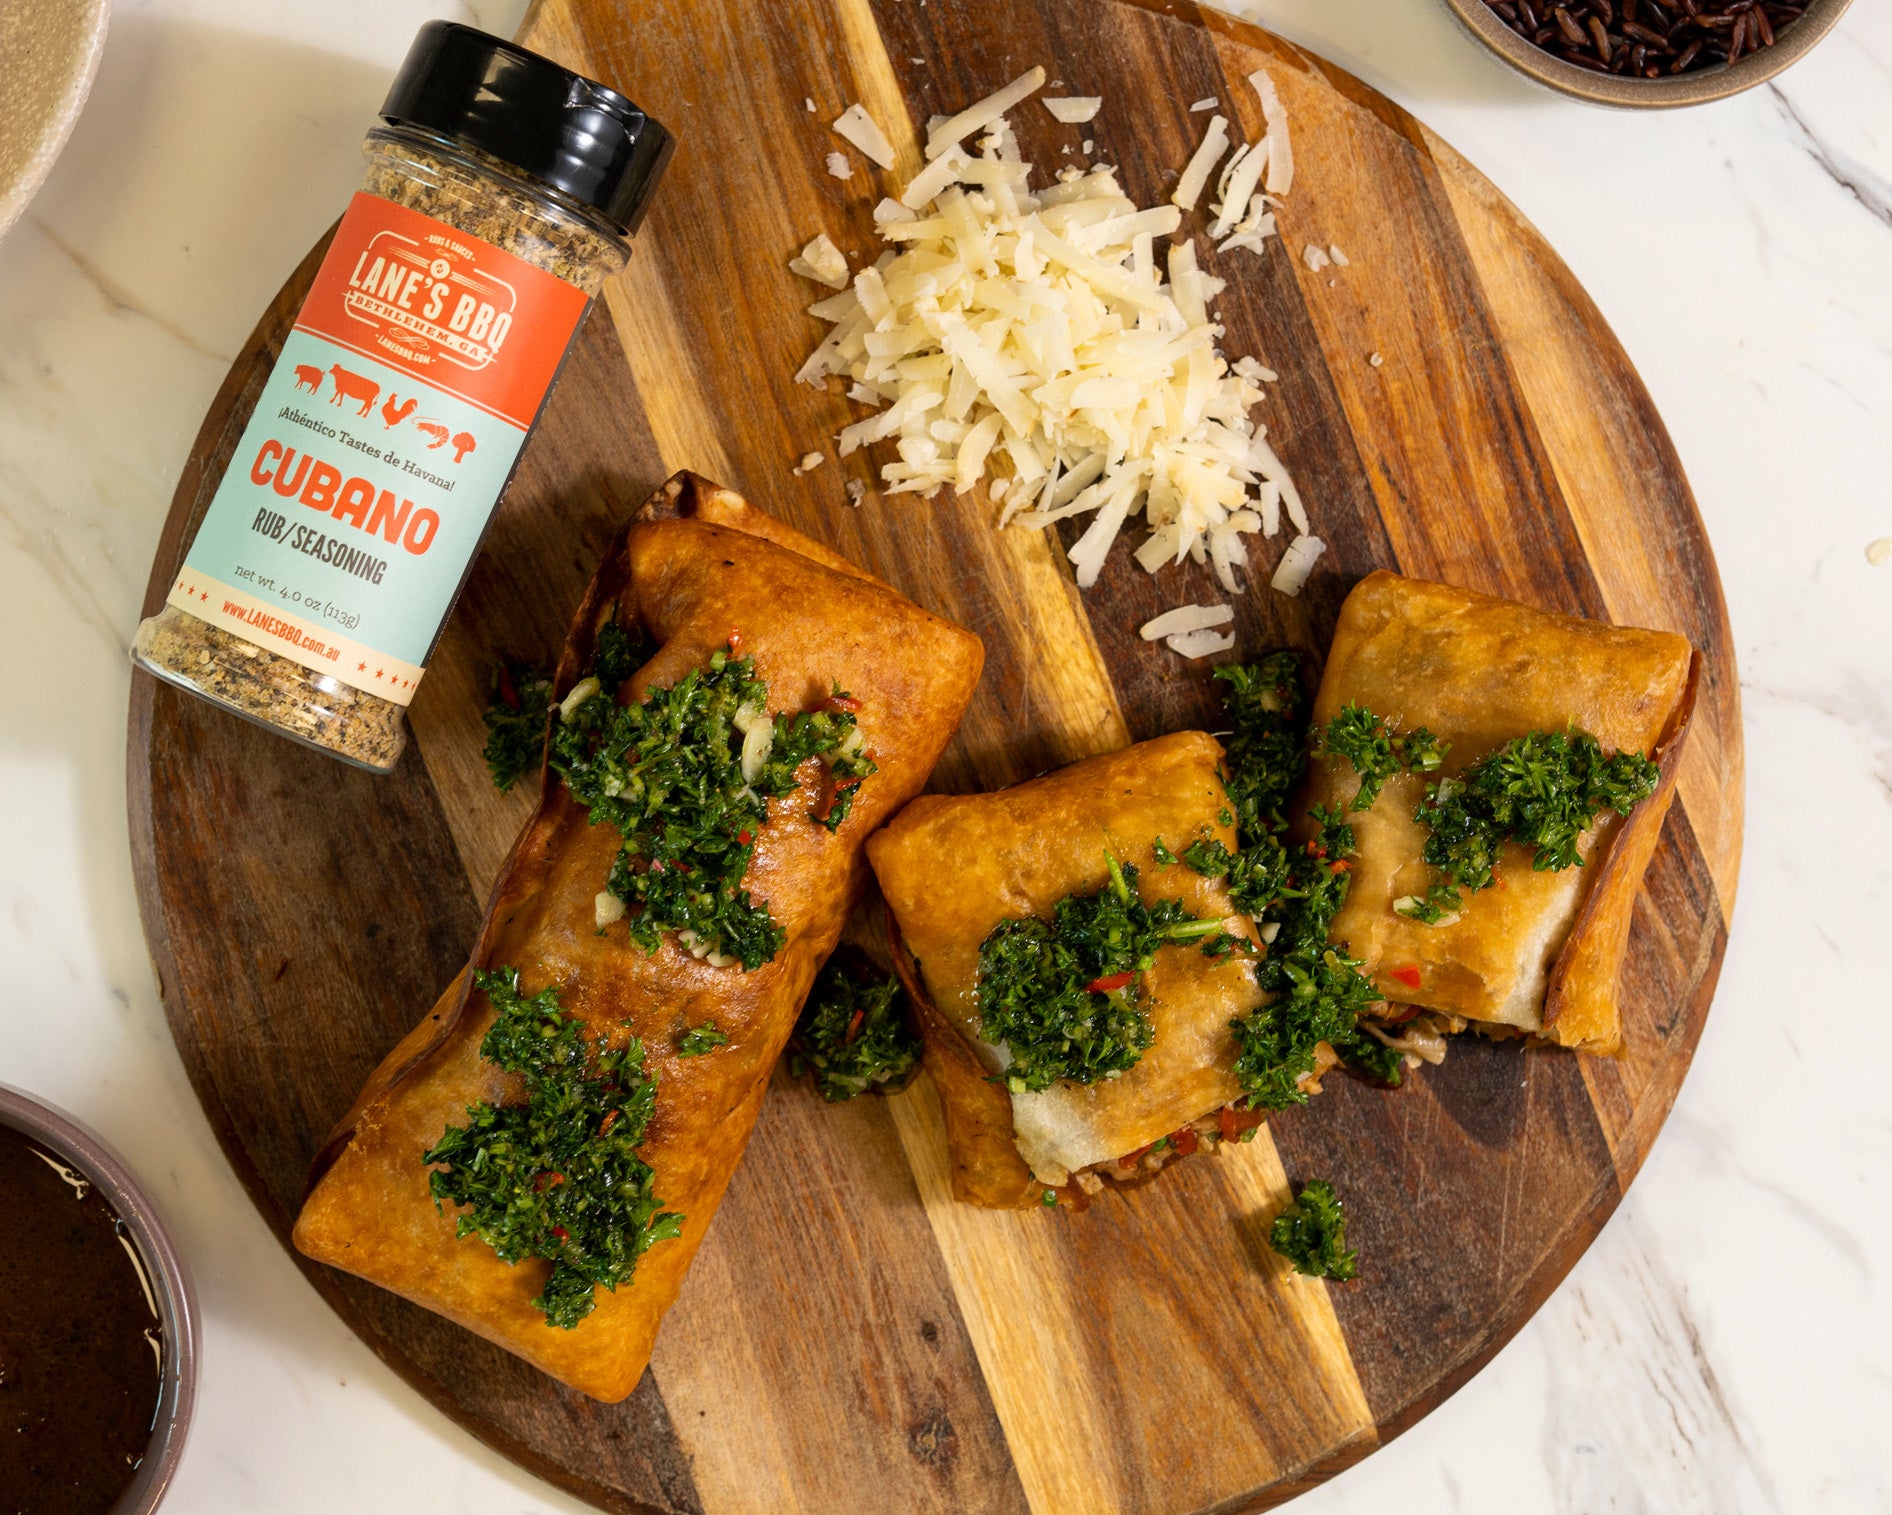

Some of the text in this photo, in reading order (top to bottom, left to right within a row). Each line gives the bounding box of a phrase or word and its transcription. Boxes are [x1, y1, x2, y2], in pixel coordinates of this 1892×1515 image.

[450, 241, 474, 260] SAUCES
[349, 251, 513, 354] LANE'S BBQ
[354, 295, 480, 357] BETHLEHEM, GA
[377, 335, 431, 365] LANESBBQ.COM
[277, 406, 456, 492] ¡Athéntico Tastes de Havana!
[250, 438, 440, 556] CUBANO
[252, 507, 388, 585] RUB/SEASONING
[234, 564, 361, 630] net wt. 4.0 oz (113g)
[222, 600, 341, 662] www.LANESBBQ.com.au
